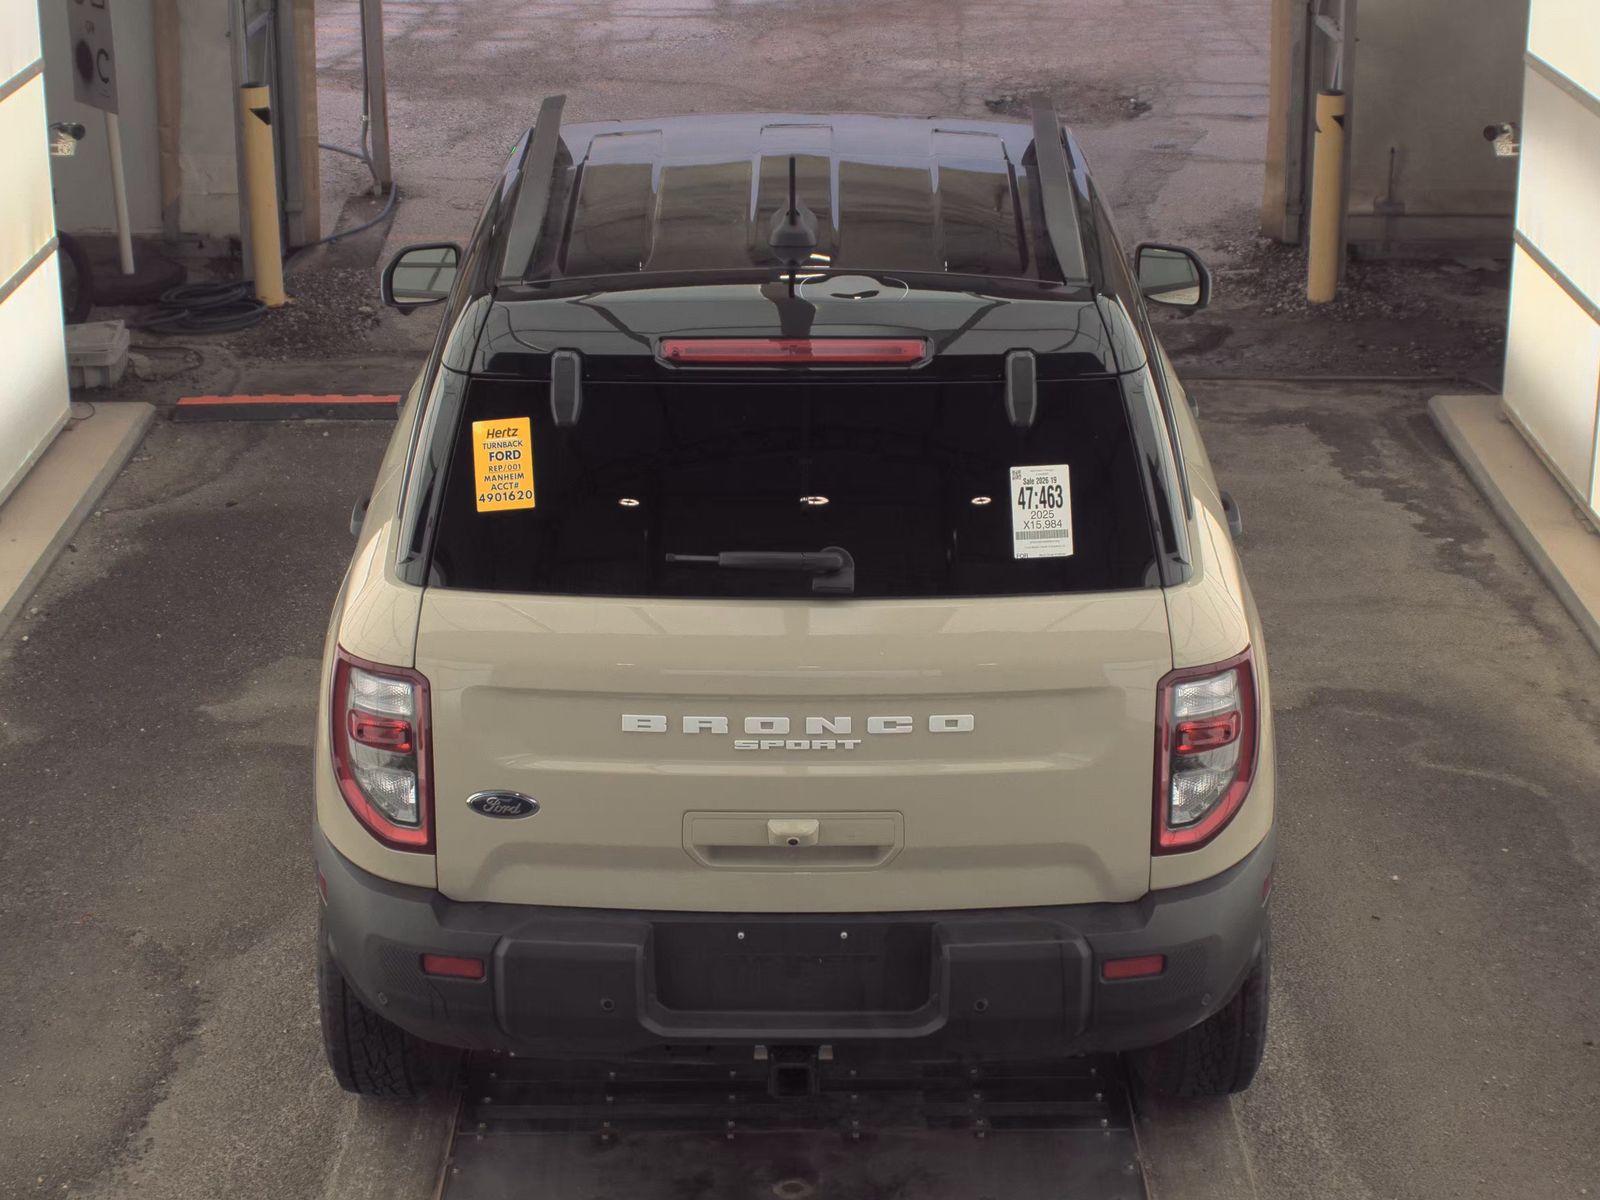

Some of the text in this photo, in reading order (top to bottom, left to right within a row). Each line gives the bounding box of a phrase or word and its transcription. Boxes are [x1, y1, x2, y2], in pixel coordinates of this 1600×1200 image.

[486, 427, 519, 439] Hertz
[482, 440, 523, 450] TURNBACK
[489, 450, 521, 462] FORD
[488, 464, 521, 472] REP/001
[484, 472, 524, 482] MANHEIM
[491, 482, 519, 490] ACCT#
[478, 490, 532, 502] 4901620
[1018, 484, 1063, 510] 47:463
[1030, 510, 1054, 520] 2025
[1023, 520, 1062, 530] X15,984
[621, 714, 975, 734] BRONCO
[734, 740, 861, 750] SPORT
[483, 796, 521, 814] Ford
